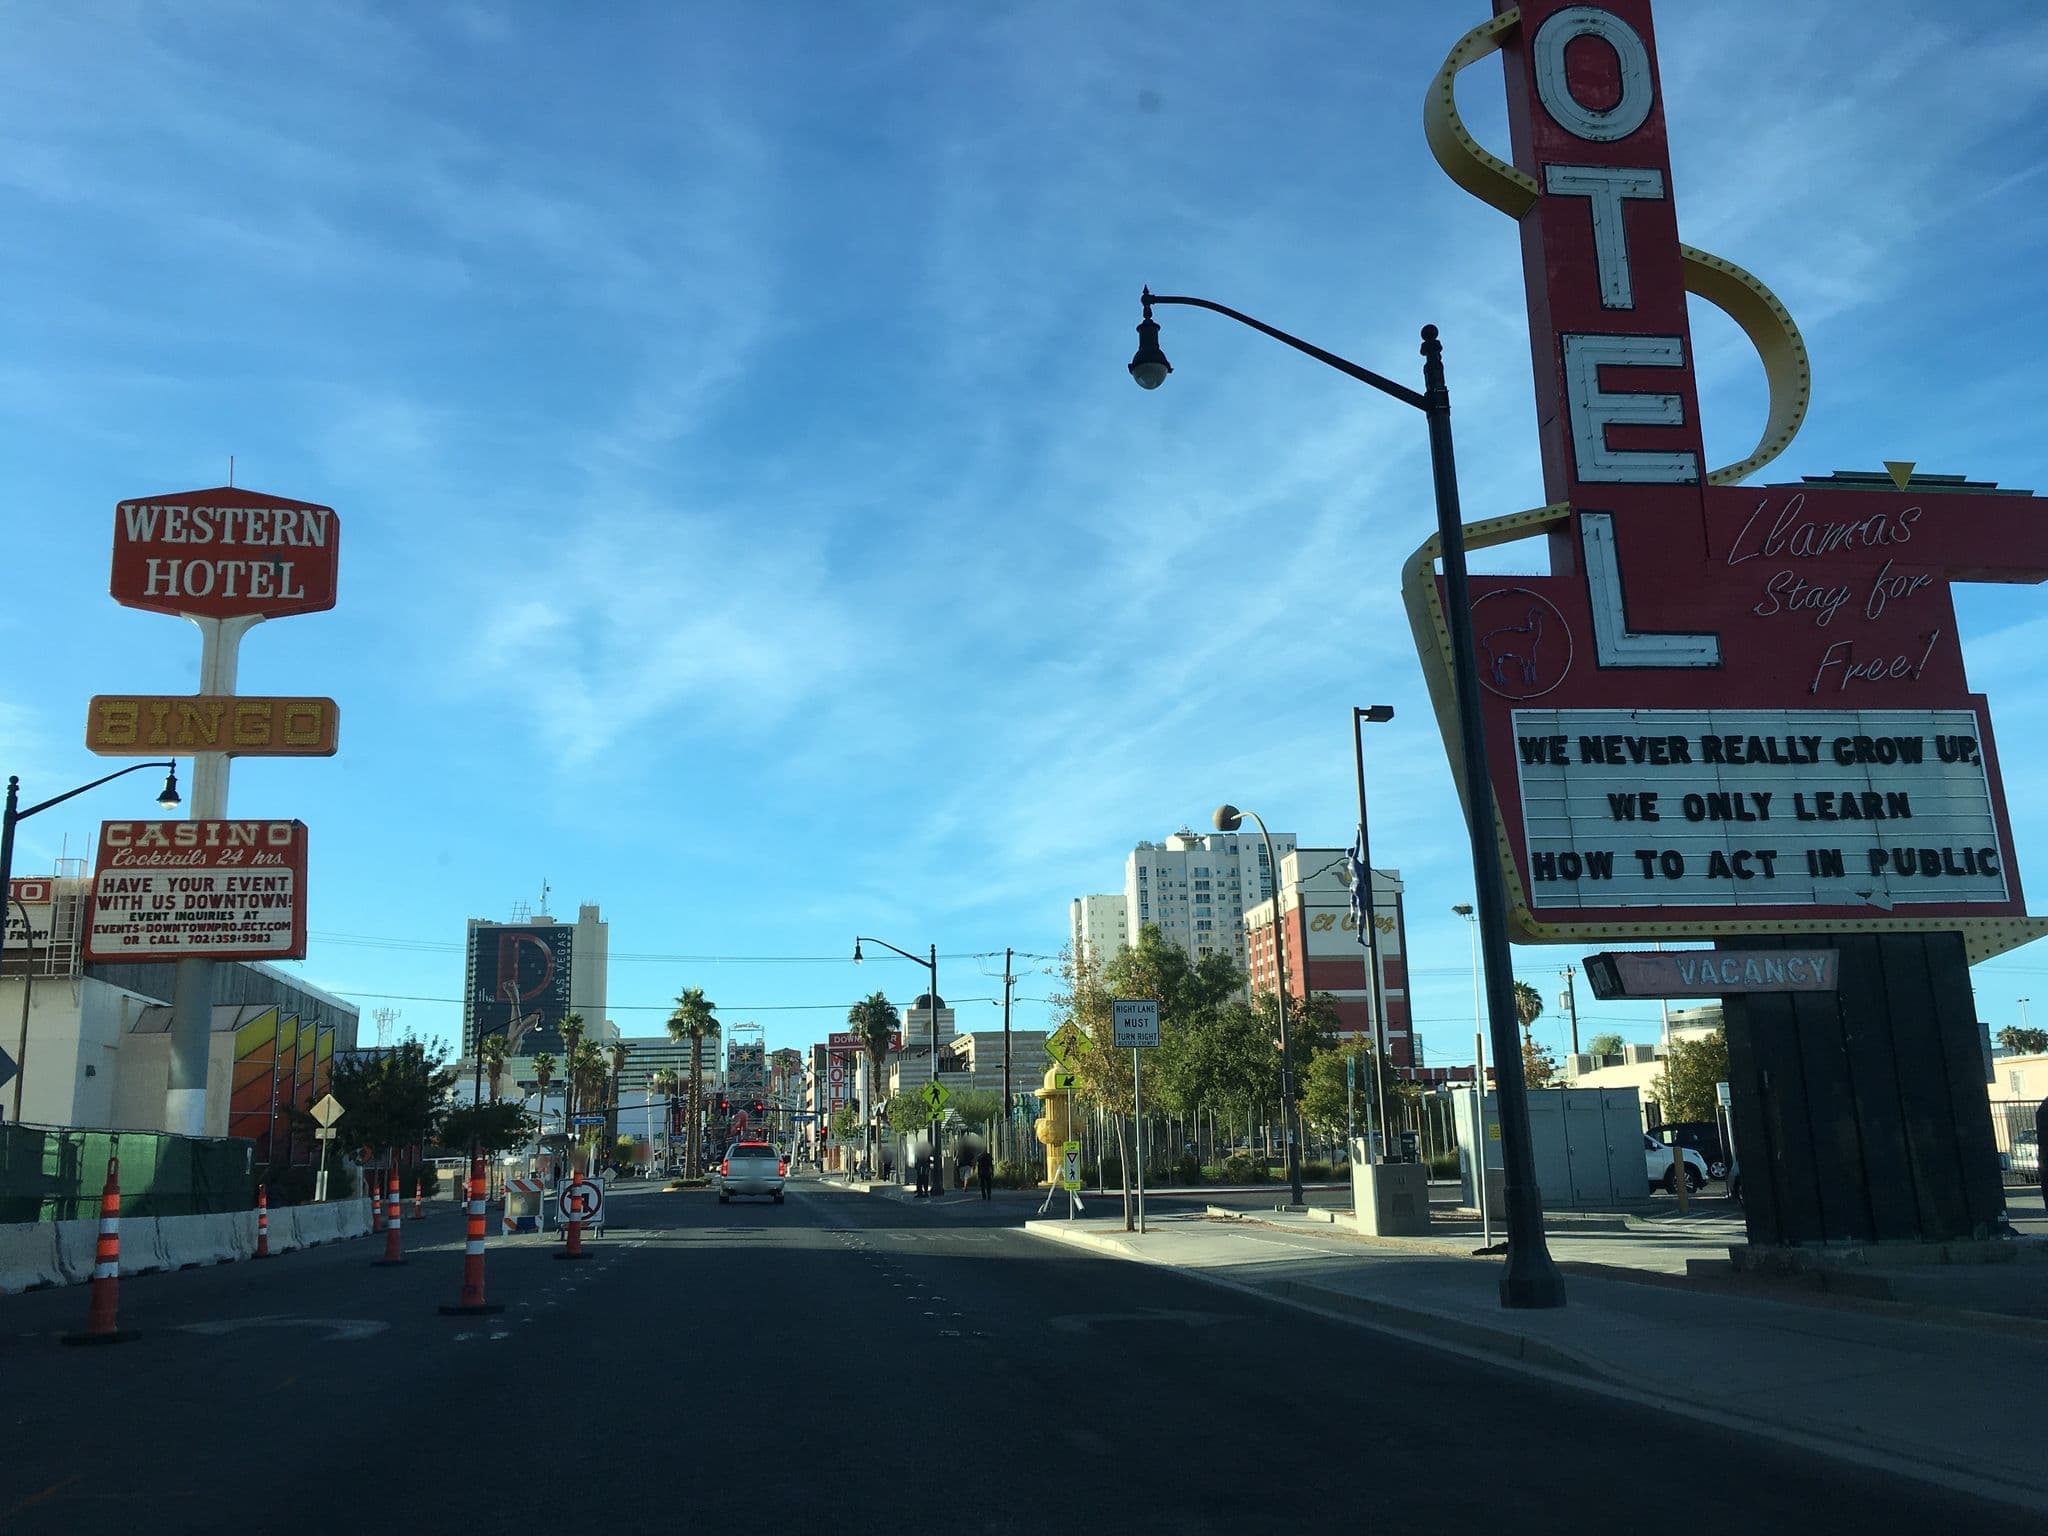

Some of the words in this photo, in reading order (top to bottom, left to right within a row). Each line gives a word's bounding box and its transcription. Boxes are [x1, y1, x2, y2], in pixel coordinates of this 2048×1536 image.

[120, 504, 330, 547] WESTERN
[1727, 492, 1922, 566] Llamas
[143, 558, 305, 600] HOTEL
[1752, 569, 1851, 627] Stay
[1865, 558, 1933, 620] for
[1810, 628, 1941, 694] Free!
[96, 701, 322, 745] BINGO
[1518, 735, 1570, 765] WE
[1578, 734, 1693, 765] NEVER
[1701, 734, 1822, 765] REALLY
[1833, 735, 1924, 766] GROW
[1935, 735, 1981, 767] UP,
[1607, 792, 1661, 822] WE
[1682, 792, 1773, 822] ONLY
[1794, 791, 1913, 821] LEARN
[106, 823, 292, 847] CASINO
[111, 847, 206, 866] Cocktails
[215, 848, 244, 866] 24
[251, 848, 285, 866] hrs.
[1532, 851, 1615, 882] HOW
[1635, 850, 1685, 880] TO
[1708, 850, 1778, 880] ACT
[1806, 848, 1846, 878] IN
[1868, 847, 2000, 877] PUBLIC
[103, 878, 153, 893] HAVE
[168, 877, 214, 892] YOUR
[226, 876, 289, 892] EVENT
[96, 895, 143, 911] WITH
[152, 895, 176, 910] US
[184, 894, 293, 910] DOWNTOWN!
[129, 911, 170, 922] EVENT
[174, 911, 235, 921] INQUIRIES
[243, 910, 259, 920] AT
[1310, 912, 1337, 933] El
[122, 934, 140, 945] OR
[149, 934, 180, 945] CALL
[555, 931, 567, 973] VEGAS
[1675, 956, 1827, 986] VACANCY
[555, 979, 566, 1001] LAS
[1115, 1005, 1136, 1014] RIGHT
[1137, 1005, 1156, 1014] LANE
[1124, 1018, 1149, 1028] MUST
[1117, 1032, 1136, 1041] TURN
[1137, 1032, 1157, 1041] RIGHT
